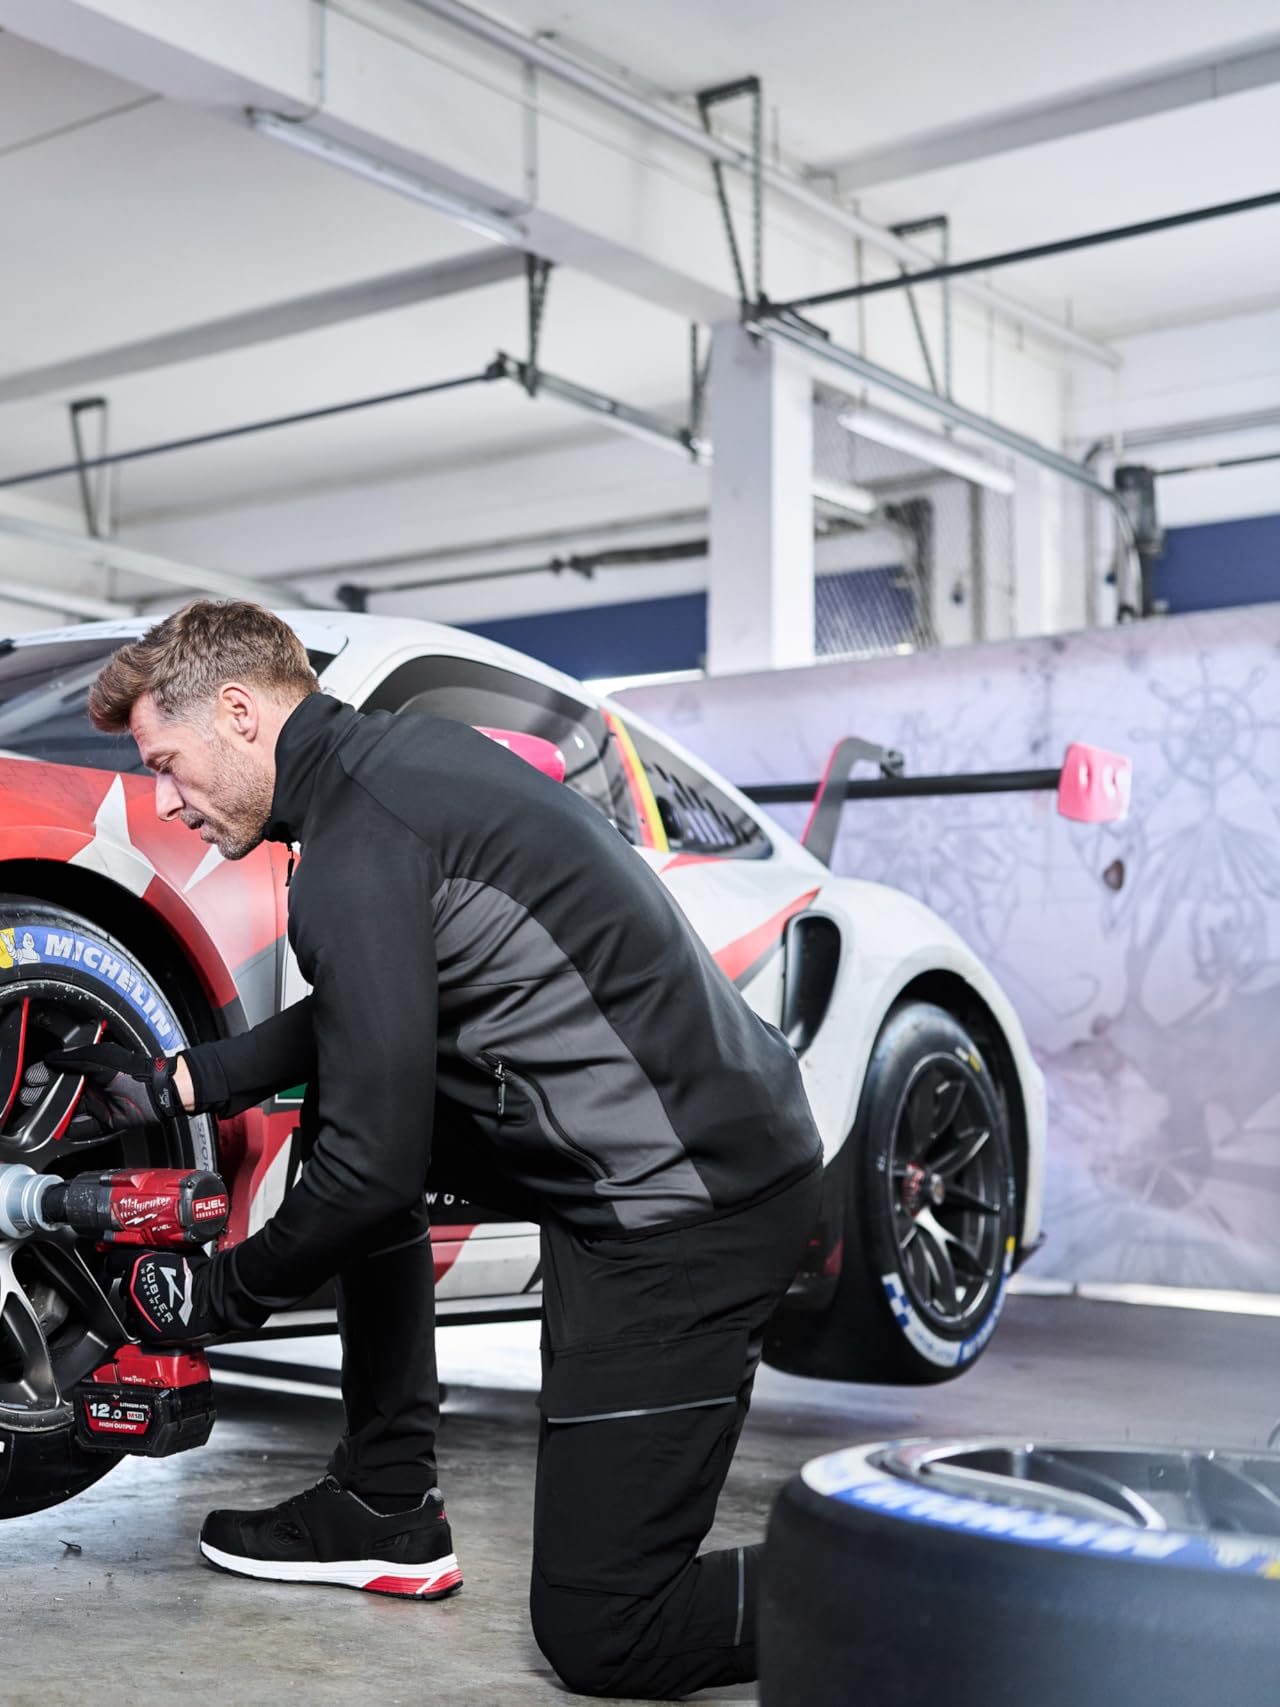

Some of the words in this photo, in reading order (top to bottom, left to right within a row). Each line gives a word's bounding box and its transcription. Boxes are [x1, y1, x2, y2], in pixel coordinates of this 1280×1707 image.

[44, 933, 172, 1038] MICHELIN
[197, 1119, 211, 1172] SPOR
[195, 1199, 226, 1213] FUEL
[113, 1422, 137, 1431] OUTPUT
